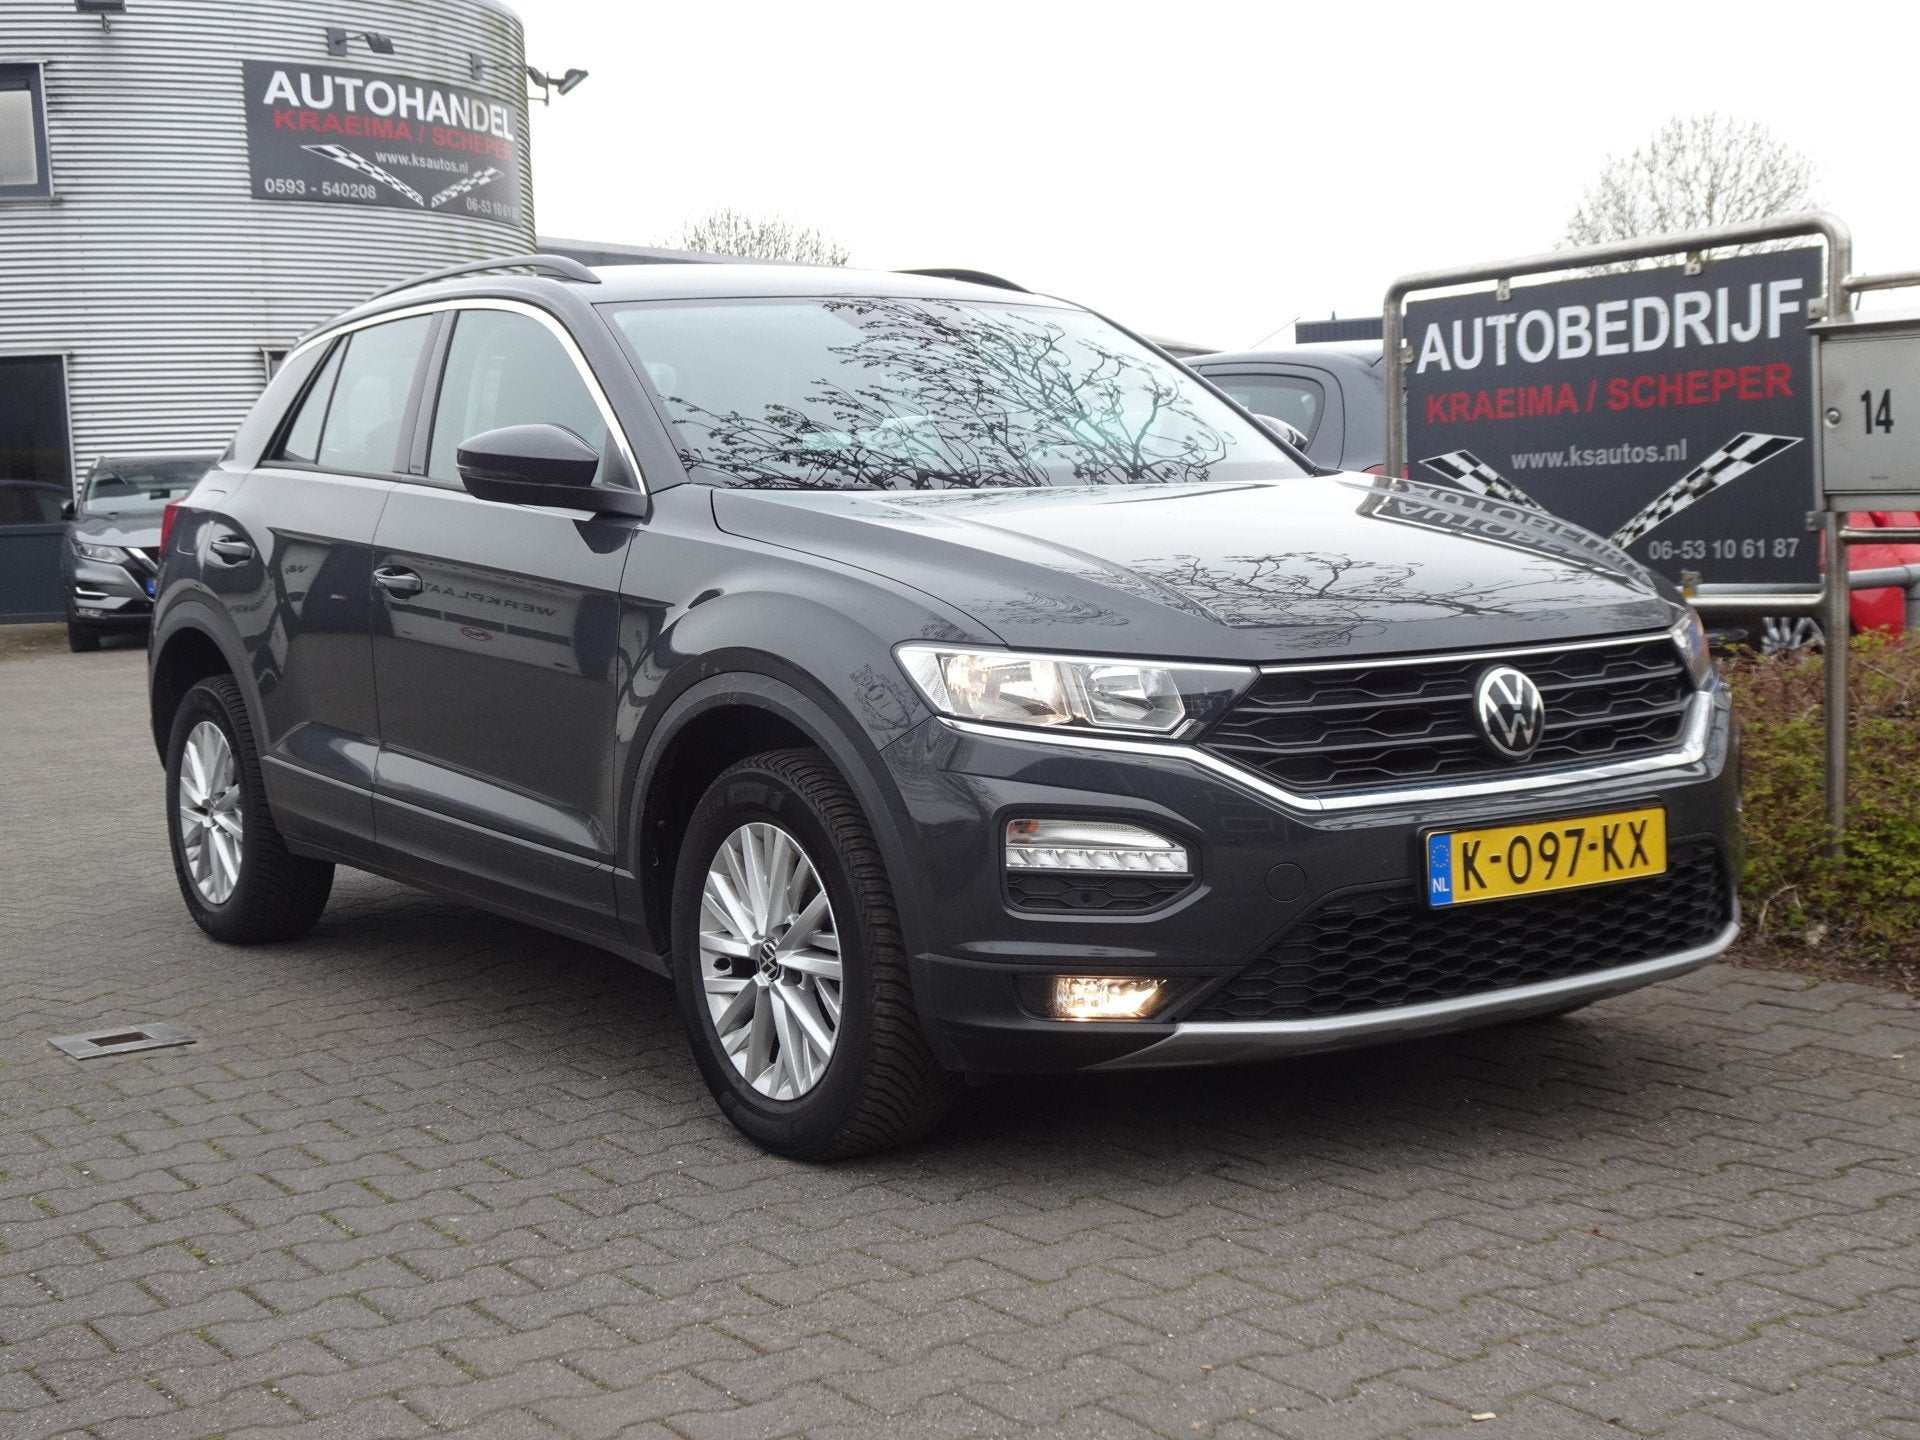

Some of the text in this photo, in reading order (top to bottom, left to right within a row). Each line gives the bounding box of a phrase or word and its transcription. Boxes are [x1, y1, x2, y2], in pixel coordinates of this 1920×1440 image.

[263, 70, 515, 141] AUTOHANDEL
[273, 109, 413, 144] KRAEIMA
[431, 126, 513, 162] SCHEPER
[375, 151, 469, 174] www.ksautos.nl
[264, 178, 306, 195] 0593
[322, 181, 377, 200] 540208
[1415, 278, 1804, 375] AUTOBEDRIJF
[1425, 383, 1578, 425] KRAEIMA
[1606, 363, 1794, 412] SCHEPER
[1860, 388, 1895, 435] 14
[1511, 438, 1688, 470] www.ksautos.nl
[1648, 537, 1800, 560] 06-53 10 61 87
[1461, 819, 1650, 891] K-097-KX
[1432, 877, 1450, 893] NL
